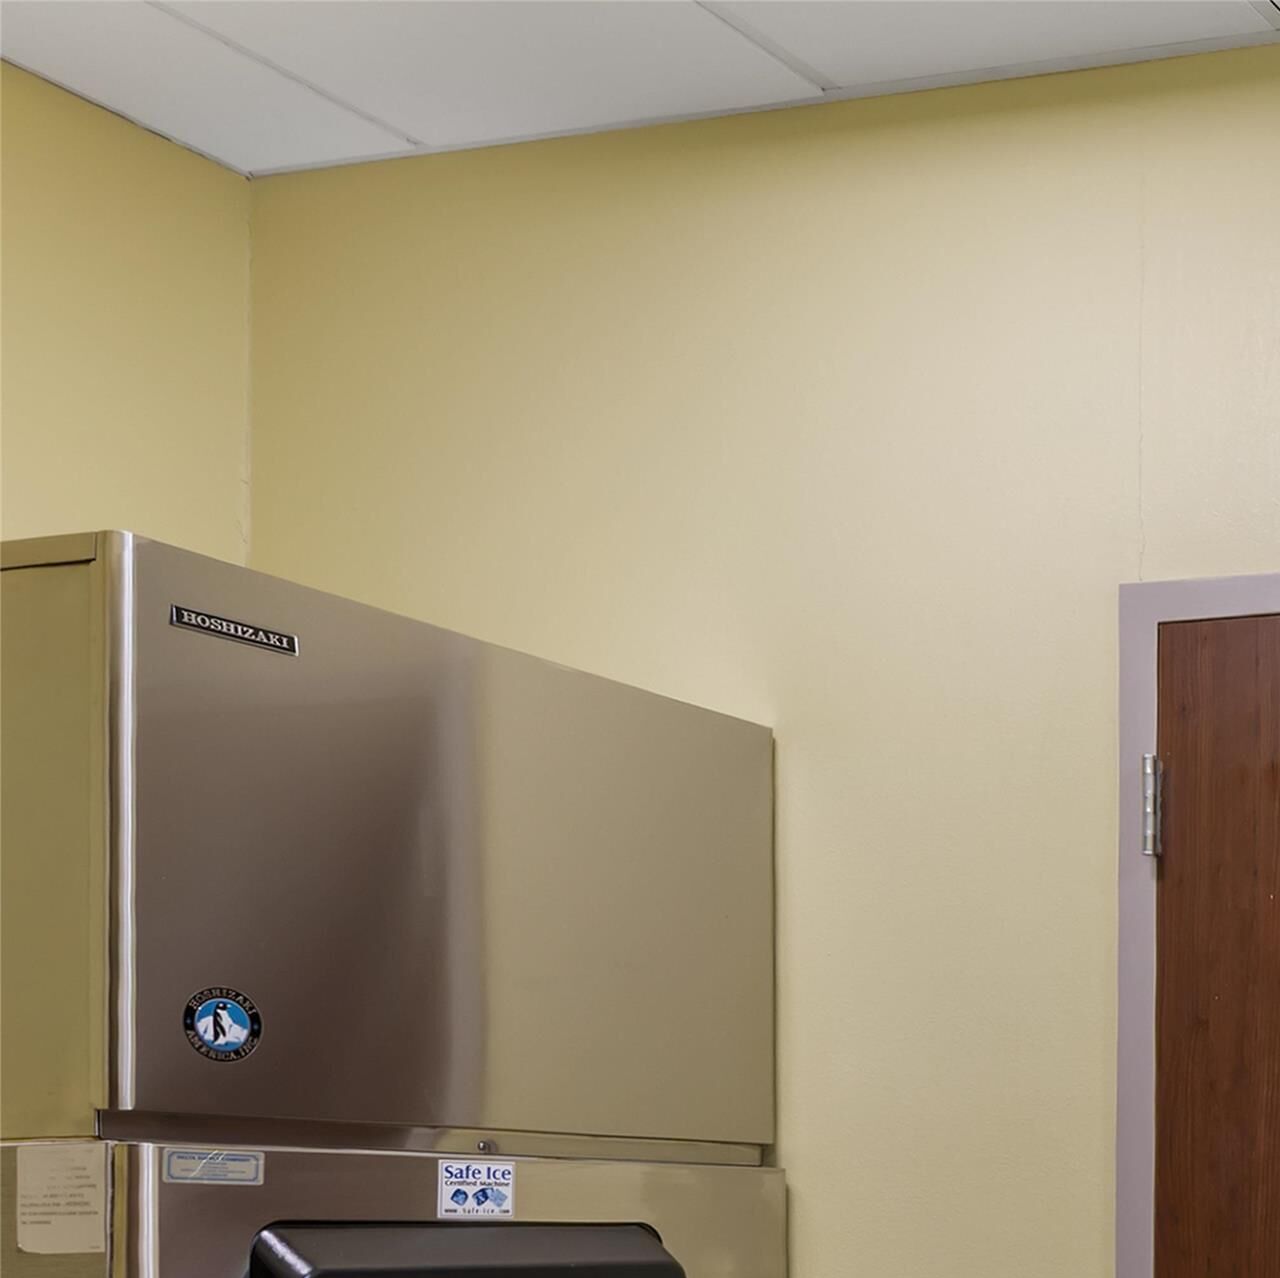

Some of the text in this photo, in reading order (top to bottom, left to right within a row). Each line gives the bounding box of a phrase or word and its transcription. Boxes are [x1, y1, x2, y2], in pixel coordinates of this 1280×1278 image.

[181, 609, 290, 649] HOSHIZAKI
[189, 989, 257, 1015] HOSHIZAKI
[444, 1165, 512, 1181] Safe Ice
